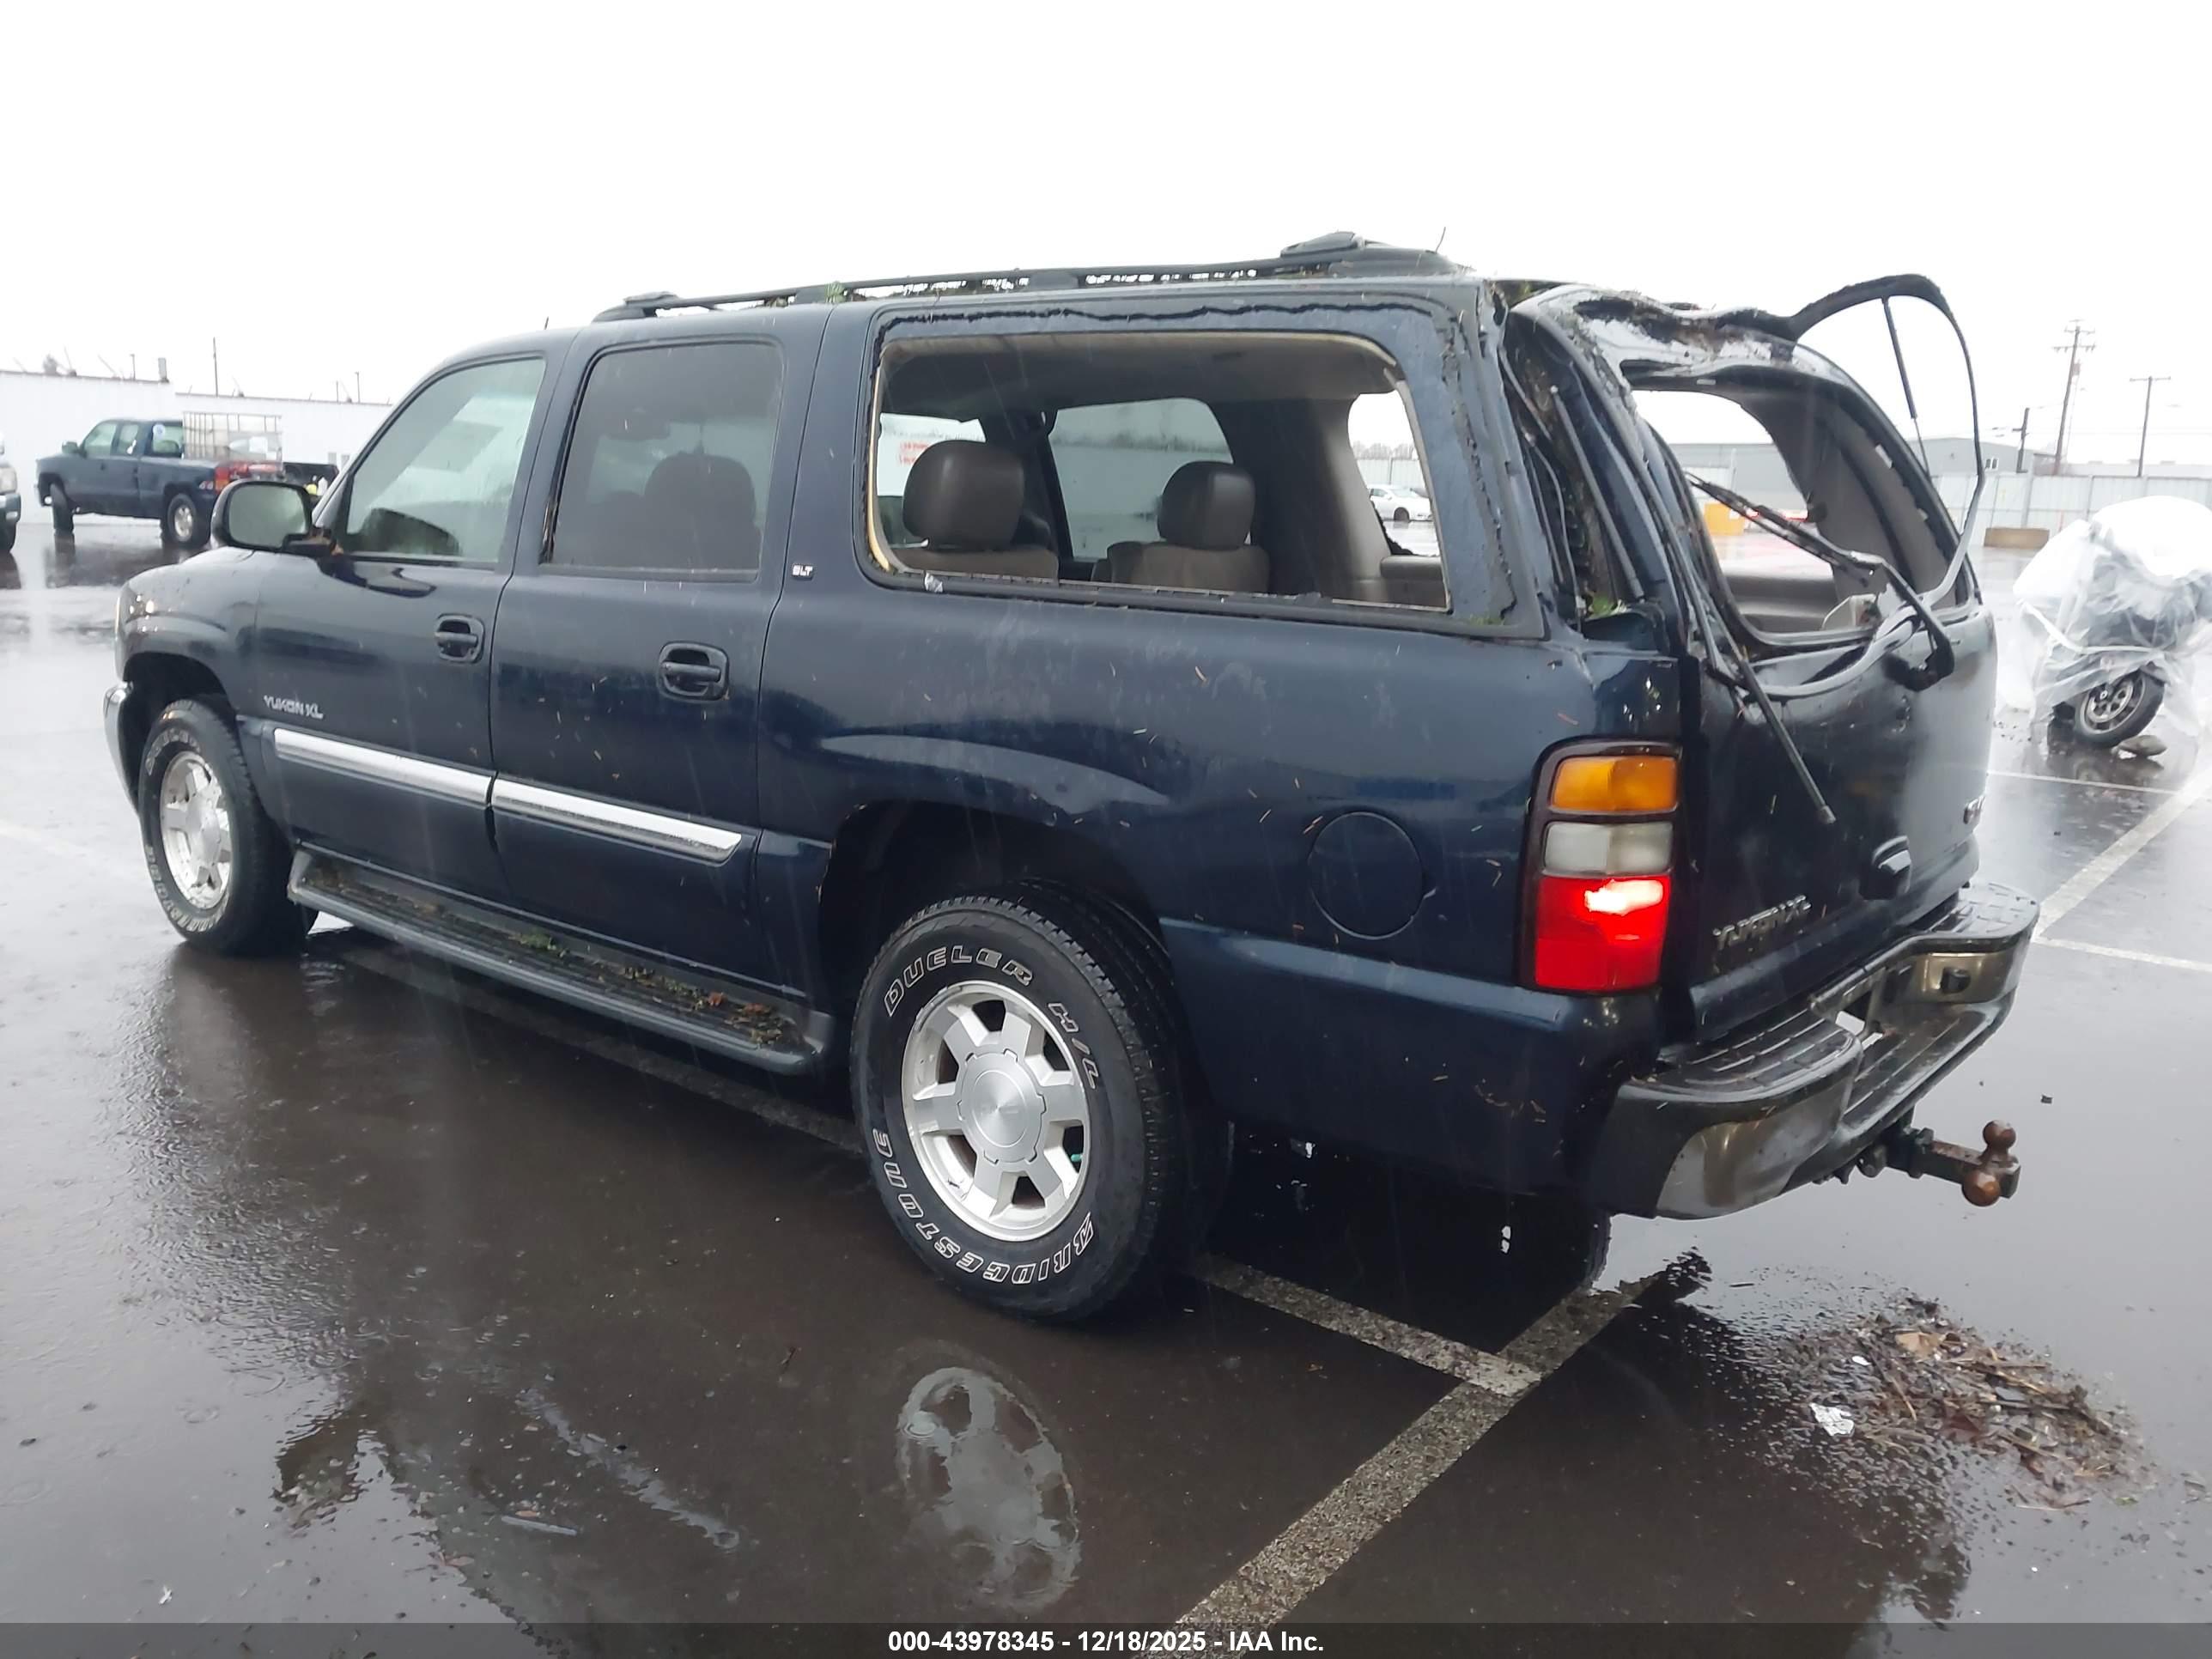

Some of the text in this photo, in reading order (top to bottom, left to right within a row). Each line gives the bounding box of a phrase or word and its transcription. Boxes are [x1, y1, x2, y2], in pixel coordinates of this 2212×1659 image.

[263, 695, 324, 720] YUKON XL
[884, 945, 1035, 1018] DUELER
[872, 1127, 1095, 1285] BRIDGESTONE
